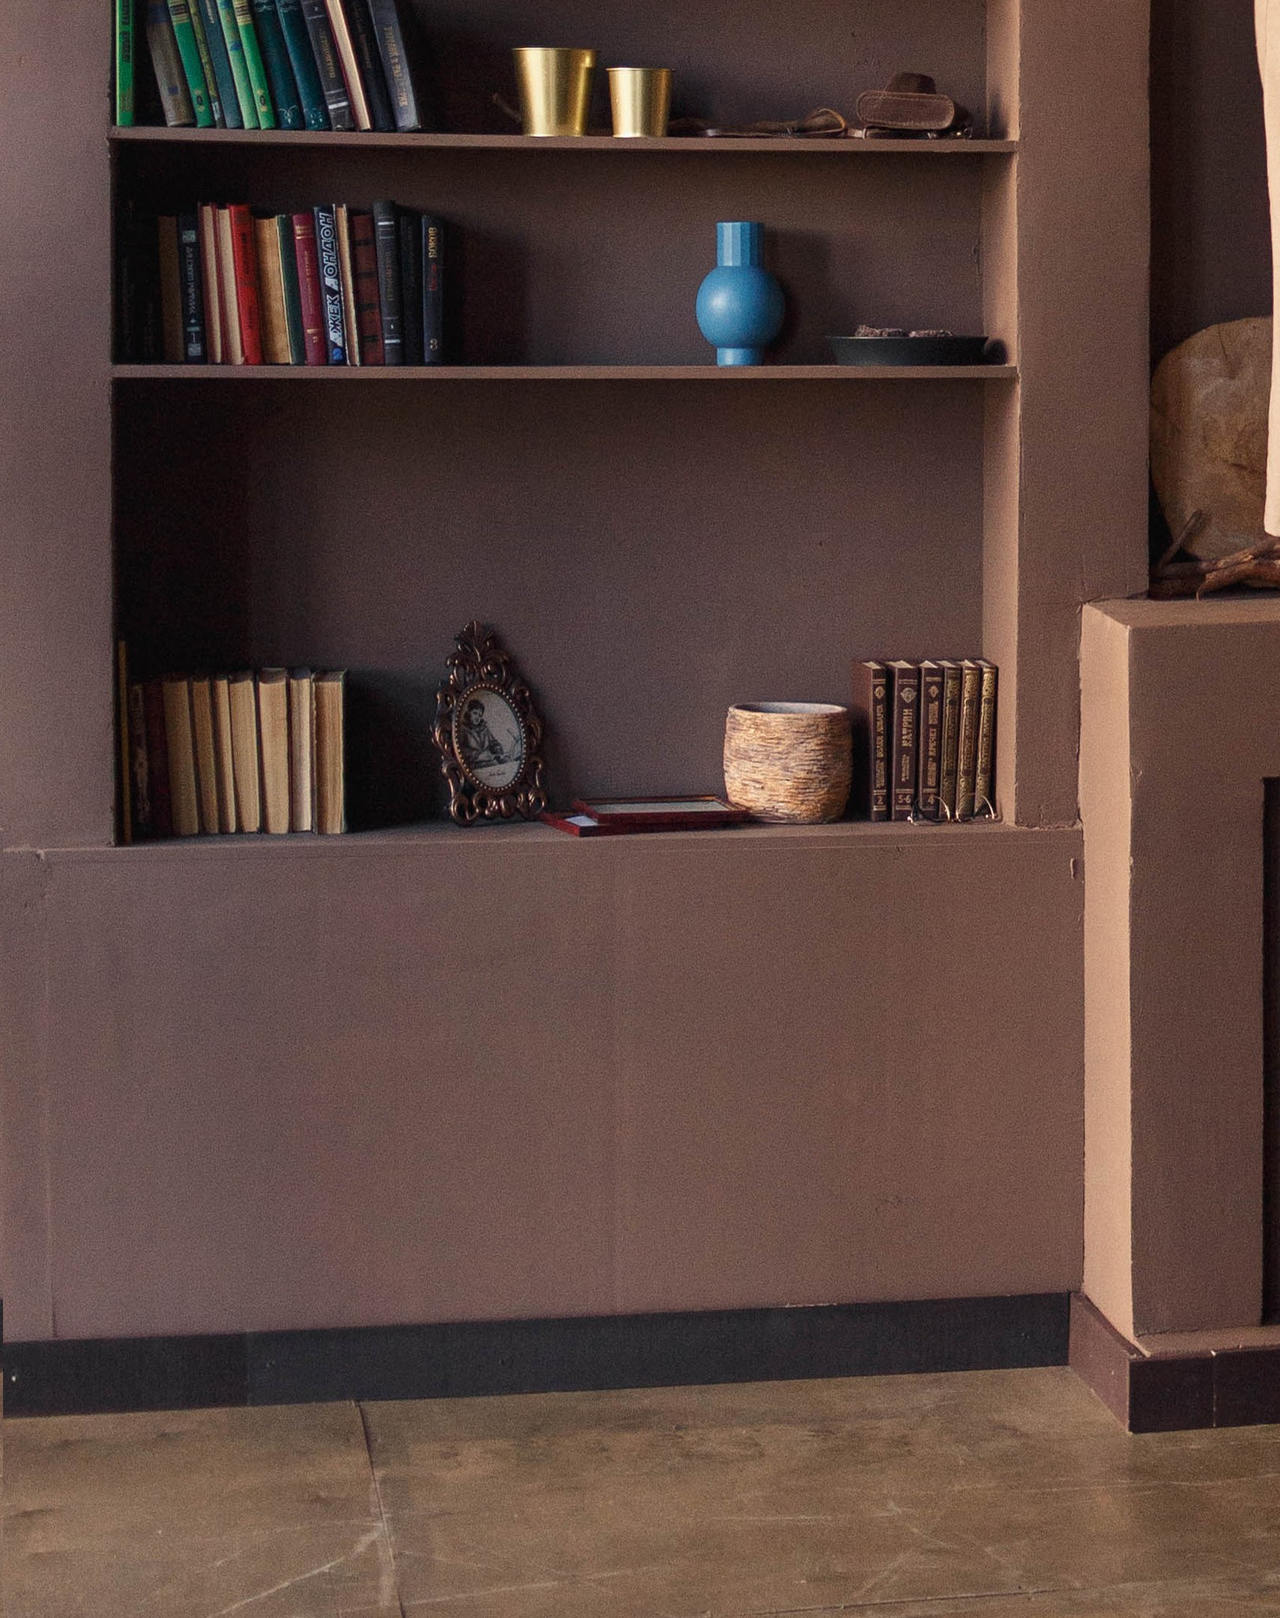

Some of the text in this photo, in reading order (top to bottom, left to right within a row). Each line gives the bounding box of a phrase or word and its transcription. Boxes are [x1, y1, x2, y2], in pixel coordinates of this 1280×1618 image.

[313, 210, 345, 344] ДЖЕК ЛОНДОН
[902, 709, 913, 747] КАТРИН
